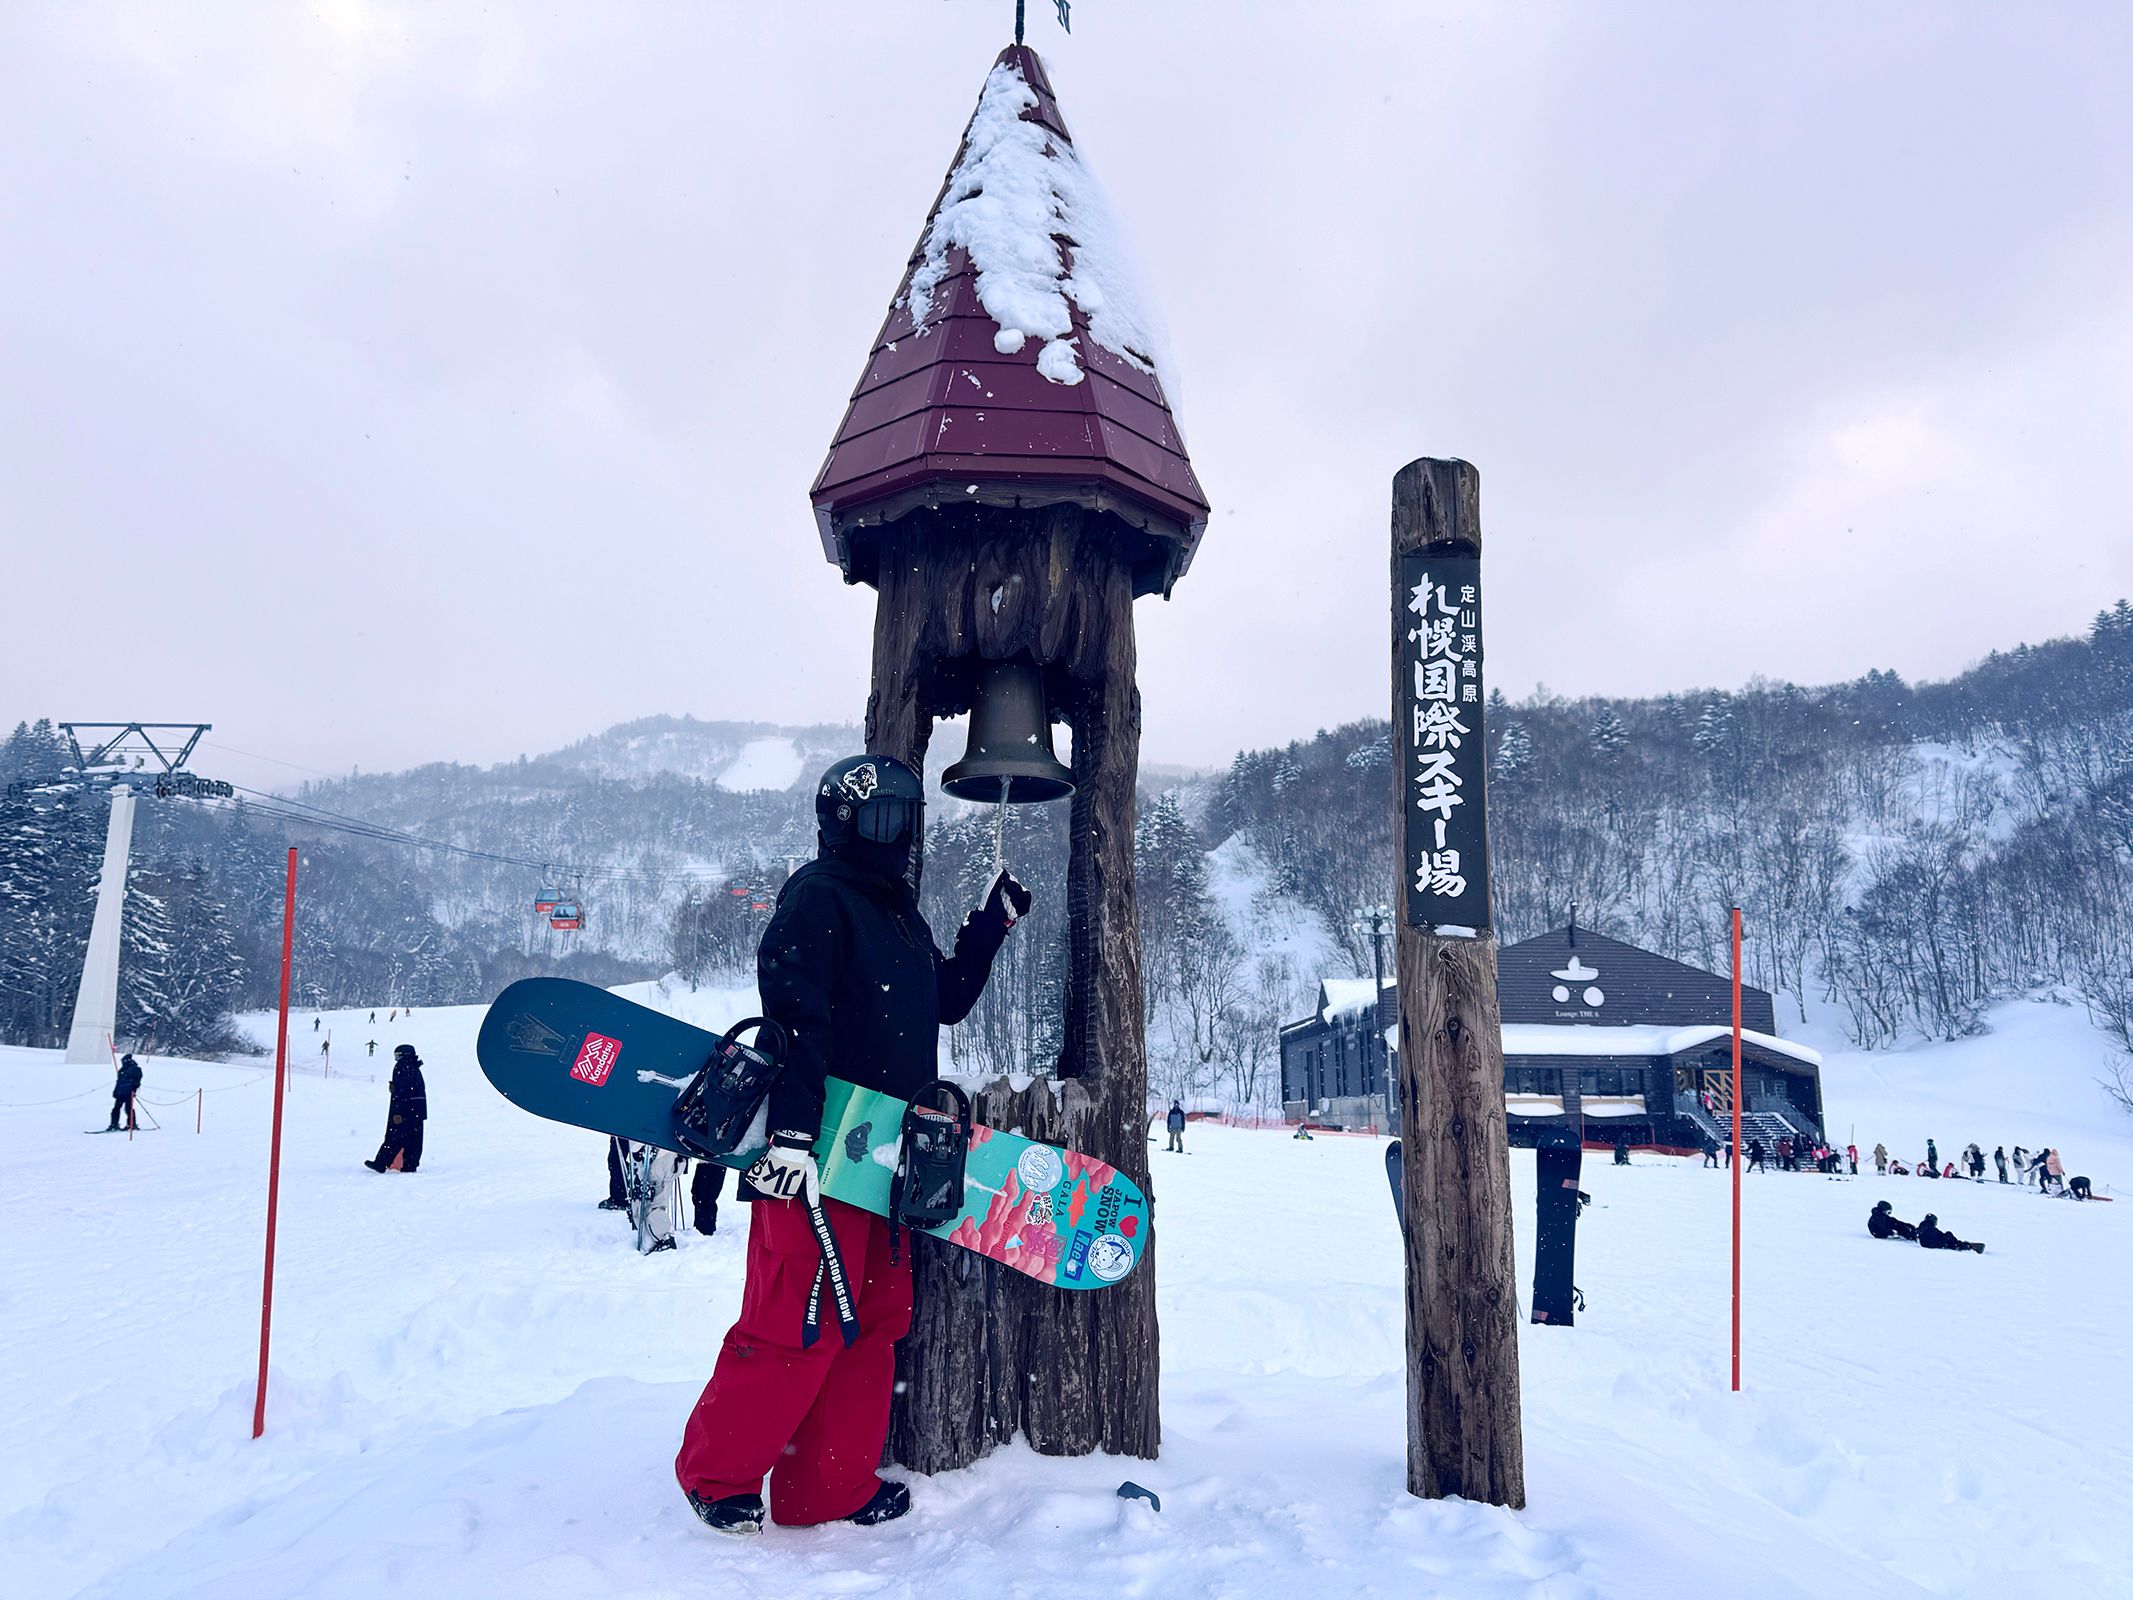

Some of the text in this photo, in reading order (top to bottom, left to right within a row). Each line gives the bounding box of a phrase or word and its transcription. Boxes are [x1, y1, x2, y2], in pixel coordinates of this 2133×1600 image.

[1460, 585, 1477, 703] 定山渓高原
[1407, 572, 1470, 897] 札幌国際スキー場
[1555, 1010, 1578, 1018] Lounge
[589, 1042, 614, 1082] Kandatsu
[1056, 1181, 1071, 1216] GALA
[1095, 1186, 1114, 1234] SNOW
[1109, 1189, 1121, 1229] JAPOW
[1124, 1195, 1142, 1208] I
[817, 1225, 835, 1258] gonna
[828, 1258, 842, 1282] stop
[811, 1284, 820, 1297] us
[835, 1282, 845, 1296] us
[807, 1298, 817, 1325] now!
[838, 1296, 854, 1322] now!
